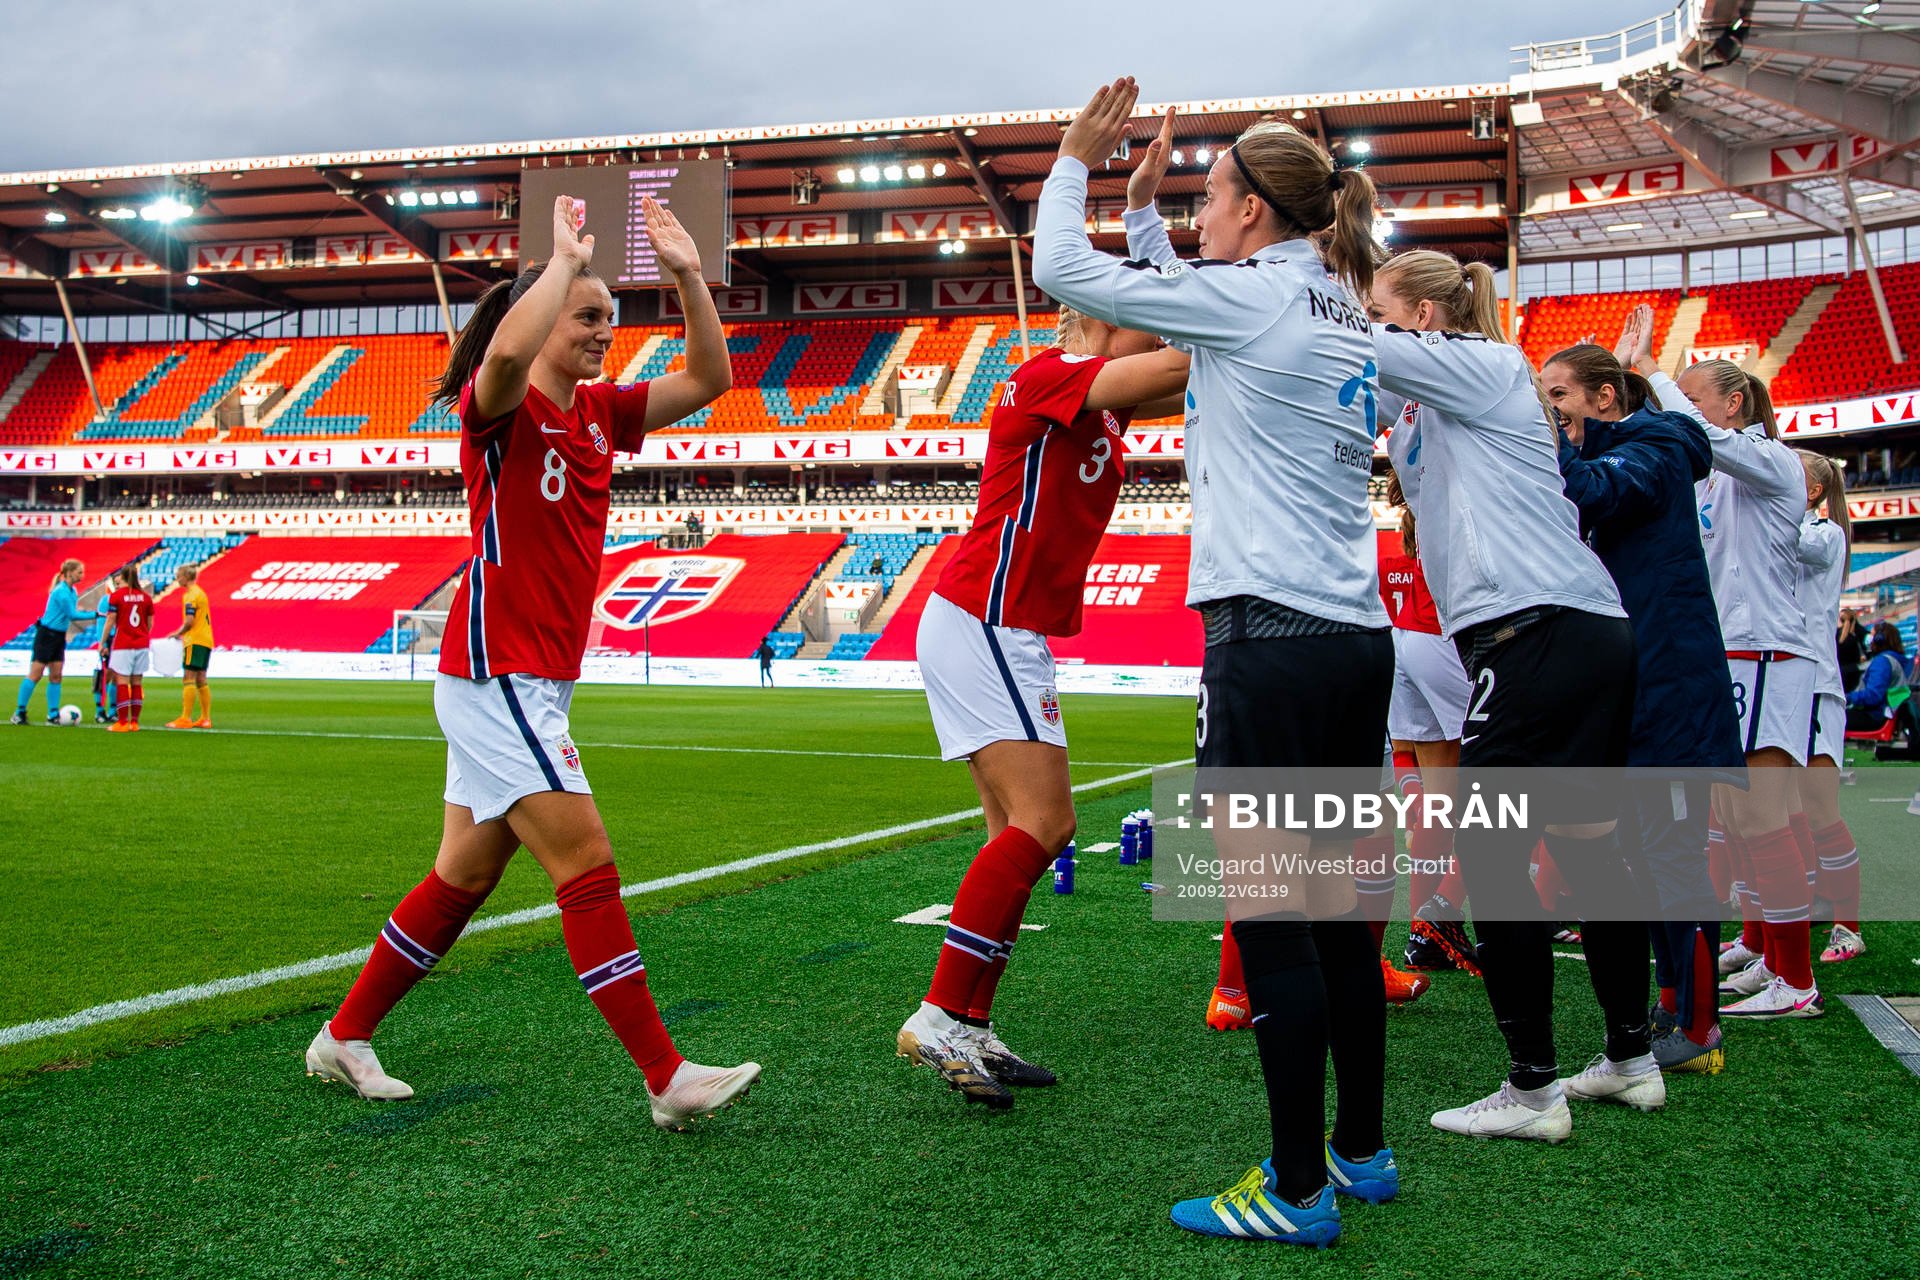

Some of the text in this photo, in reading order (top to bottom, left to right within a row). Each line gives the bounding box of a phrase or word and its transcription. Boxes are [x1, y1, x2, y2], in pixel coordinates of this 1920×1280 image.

[1771, 132, 1880, 177] VG
[1569, 162, 1684, 204] VG
[1378, 188, 1483, 210] VG
[736, 217, 836, 242] VG
[892, 209, 996, 239] VG
[198, 243, 284, 270] VG
[326, 234, 414, 264] VG
[80, 250, 160, 275] VG
[804, 284, 900, 309] VG
[942, 281, 1037, 304] VG
[899, 368, 942, 380] VG
[1872, 396, 1920, 423] V
[84, 452, 145, 469] VG
[173, 450, 236, 467] VG
[266, 448, 331, 465] VG
[361, 447, 428, 464] VG
[667, 441, 740, 459] VG
[775, 439, 850, 458] VG
[886, 438, 964, 456] VG
[1079, 437, 1111, 484] 3
[541, 448, 567, 501] 8
[7, 514, 52, 527] VG
[61, 514, 101, 526] VG
[112, 514, 152, 525] VG
[162, 514, 202, 525] VG
[213, 513, 255, 525] VG
[265, 513, 308, 524] VG
[318, 513, 361, 524] VG
[372, 512, 417, 523] VG
[427, 512, 470, 523] VG
[716, 510, 765, 521] VG
[777, 509, 826, 521] VG
[839, 509, 890, 520] VG
[902, 508, 953, 520] VG
[1848, 499, 1902, 518] VG
[251, 562, 400, 580] STERKERE
[1086, 564, 1161, 583] KERE
[230, 582, 368, 600] SAMMEN
[826, 585, 876, 598] VG
[130, 604, 141, 627] 6
[1196, 683, 1208, 748] 3
